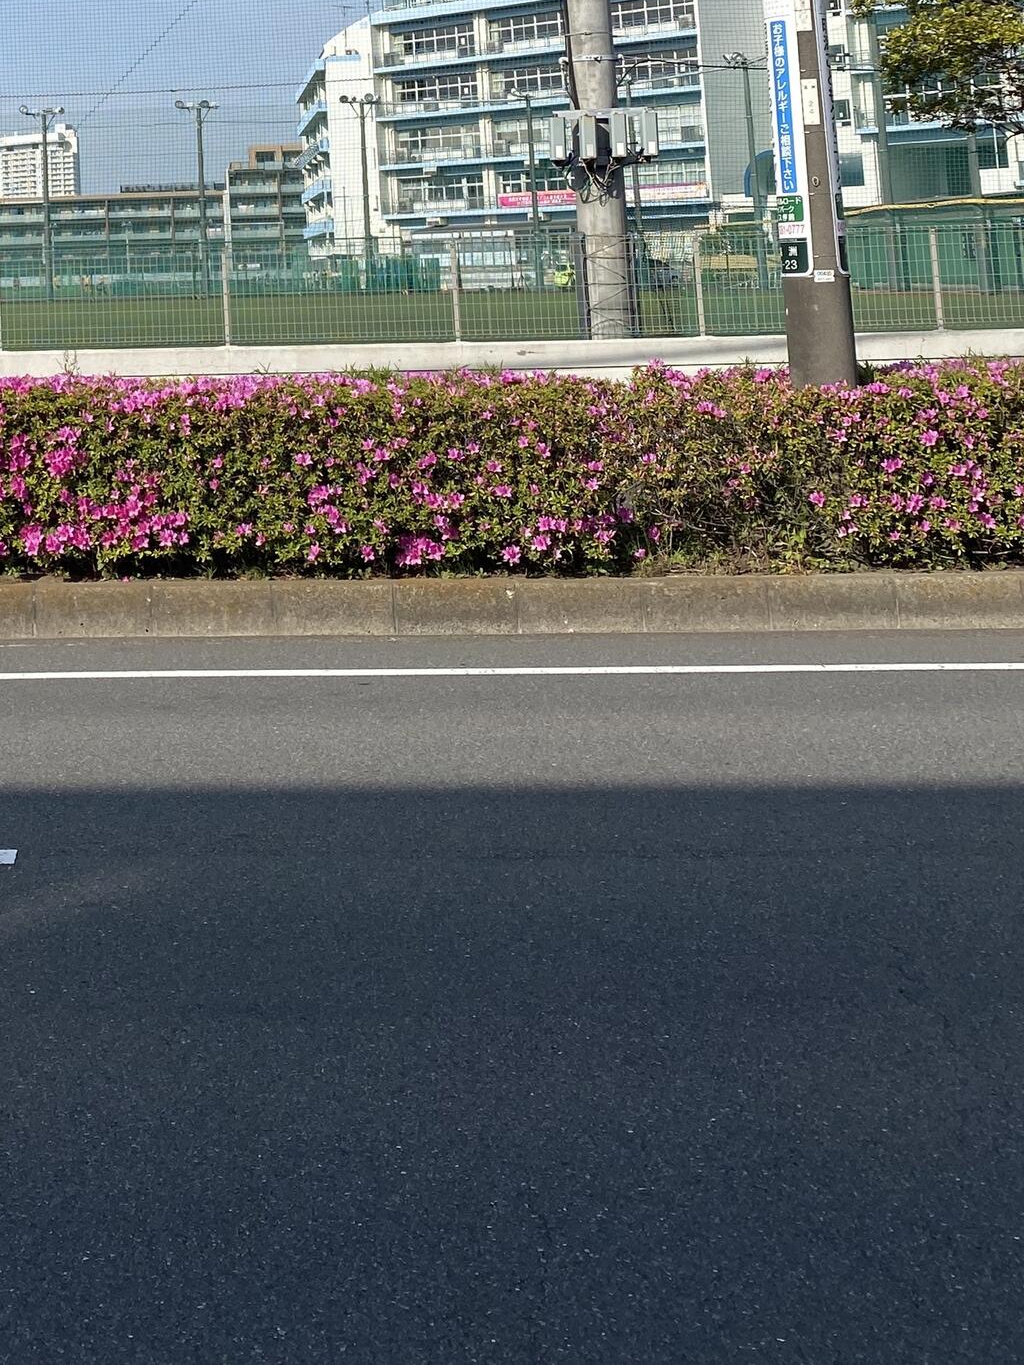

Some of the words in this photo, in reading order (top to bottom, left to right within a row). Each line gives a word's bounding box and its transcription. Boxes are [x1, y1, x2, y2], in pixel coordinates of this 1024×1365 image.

[773, 23, 794, 191] お子様のアレルギーご相談下さい
